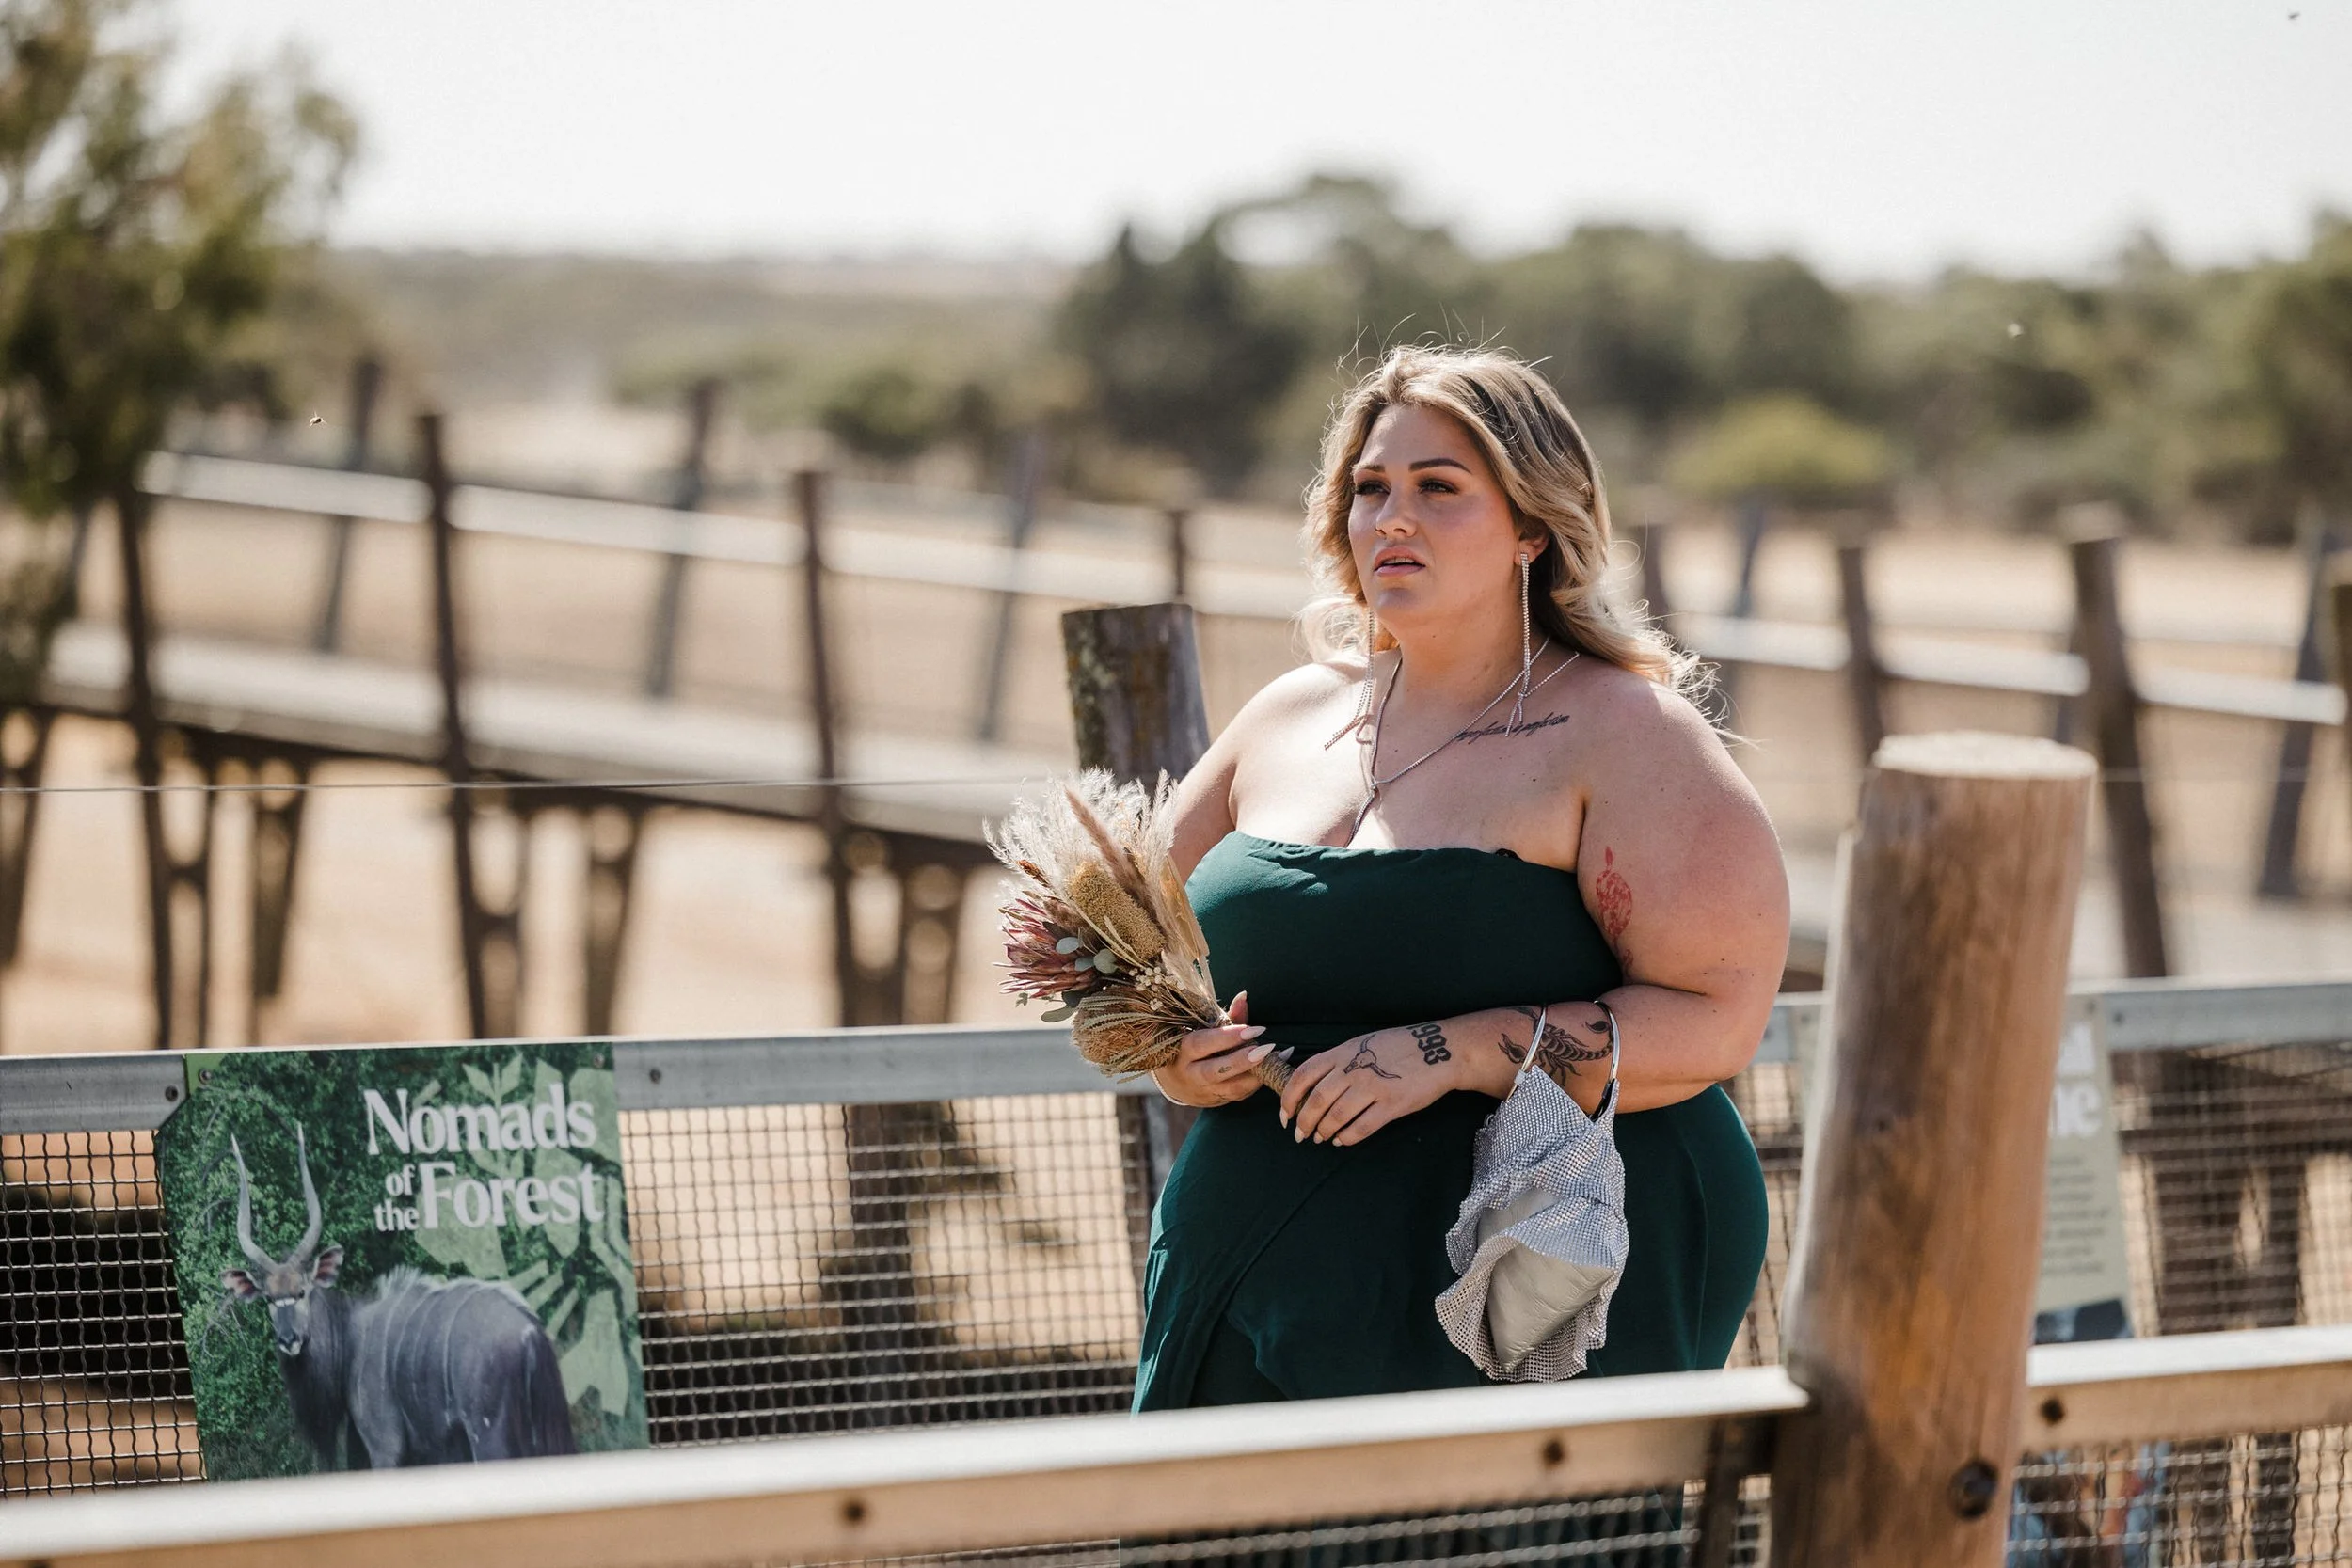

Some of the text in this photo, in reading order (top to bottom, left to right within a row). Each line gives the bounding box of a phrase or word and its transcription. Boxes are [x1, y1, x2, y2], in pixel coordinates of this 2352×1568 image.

[363, 1082, 597, 1156] Nomads
[373, 1160, 605, 1232] the Forest
[385, 1164, 417, 1196] of
